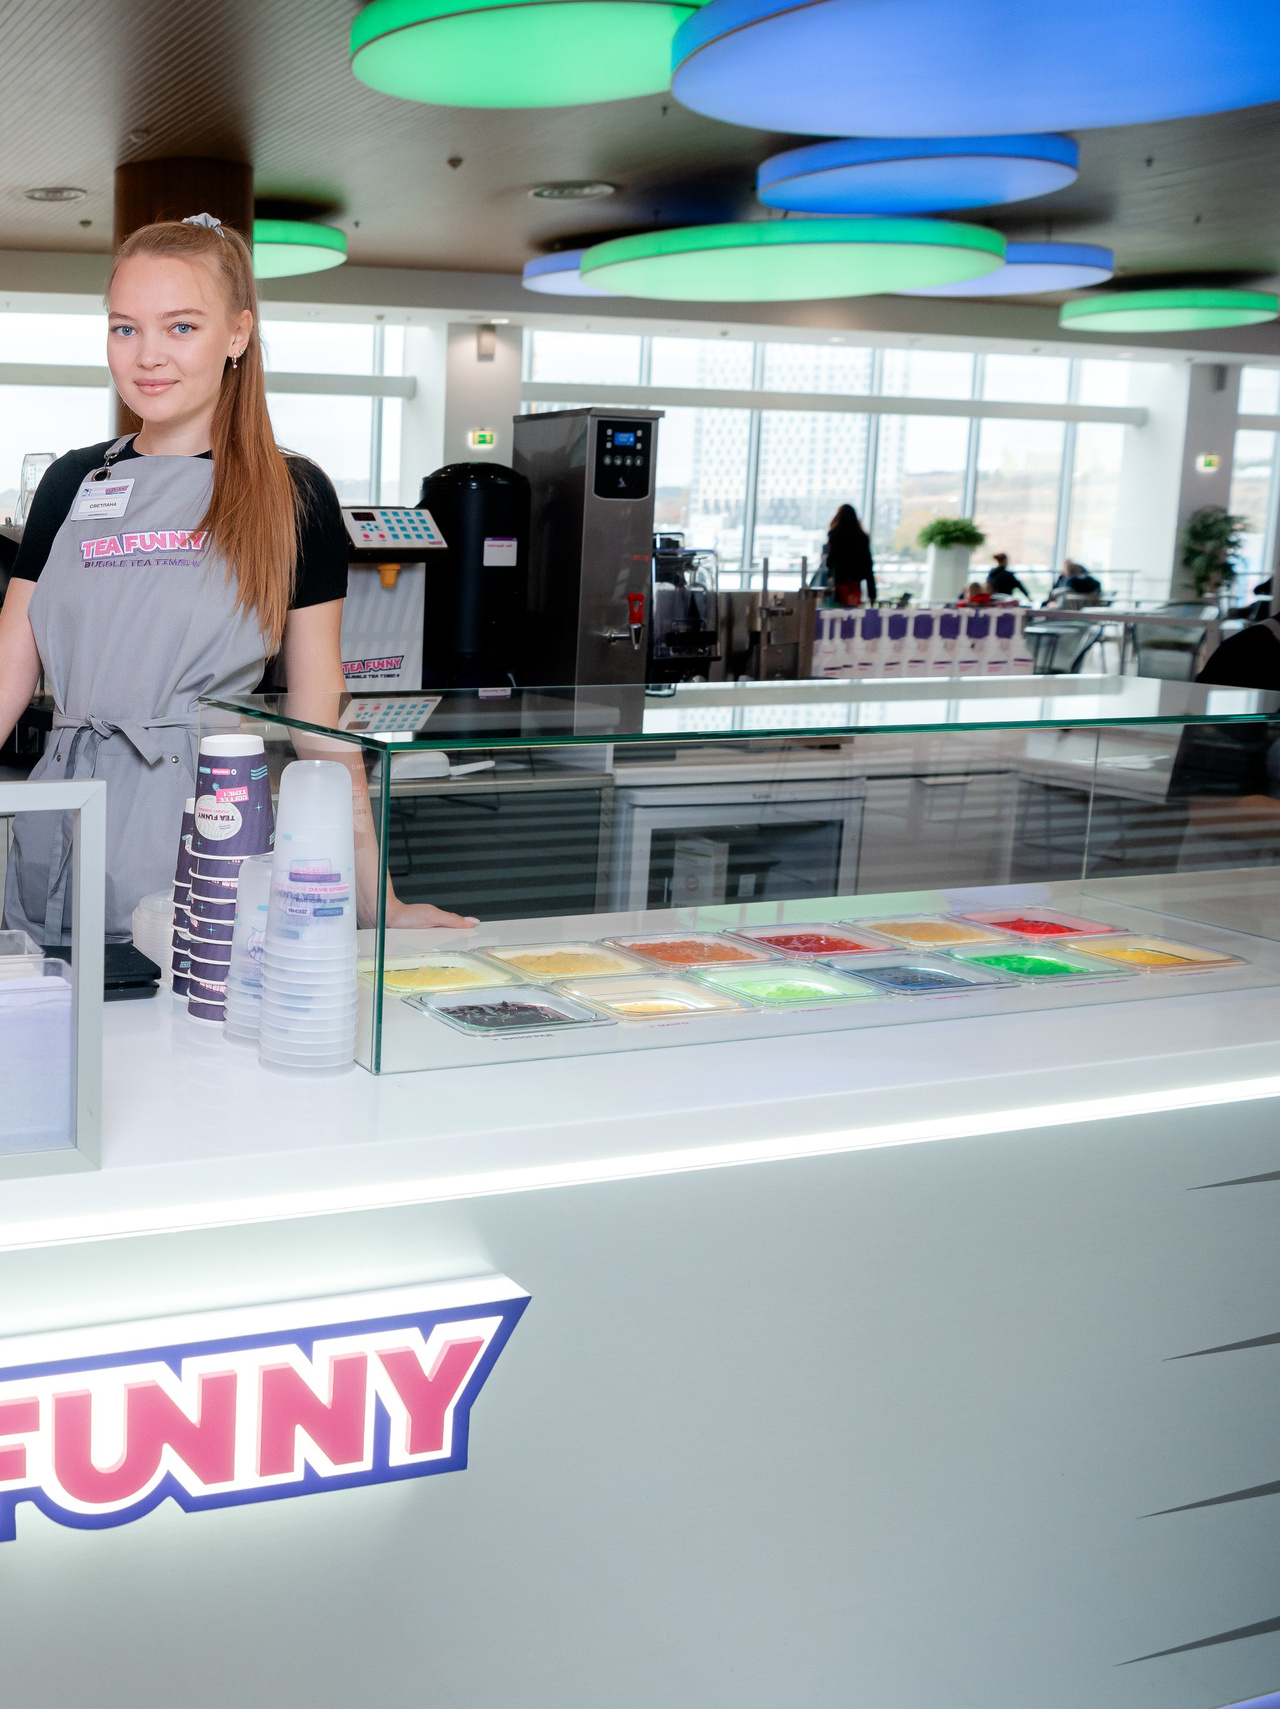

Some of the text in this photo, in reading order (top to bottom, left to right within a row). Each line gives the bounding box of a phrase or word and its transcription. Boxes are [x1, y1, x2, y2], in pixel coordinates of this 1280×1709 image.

[82, 531, 205, 558] TEA FUNNY
[343, 657, 402, 674] TEA FUNNY
[218, 795, 248, 803] COFFEE
[198, 812, 218, 821] FUNNY
[502, 1033, 555, 1041] ВИНОГРАД
